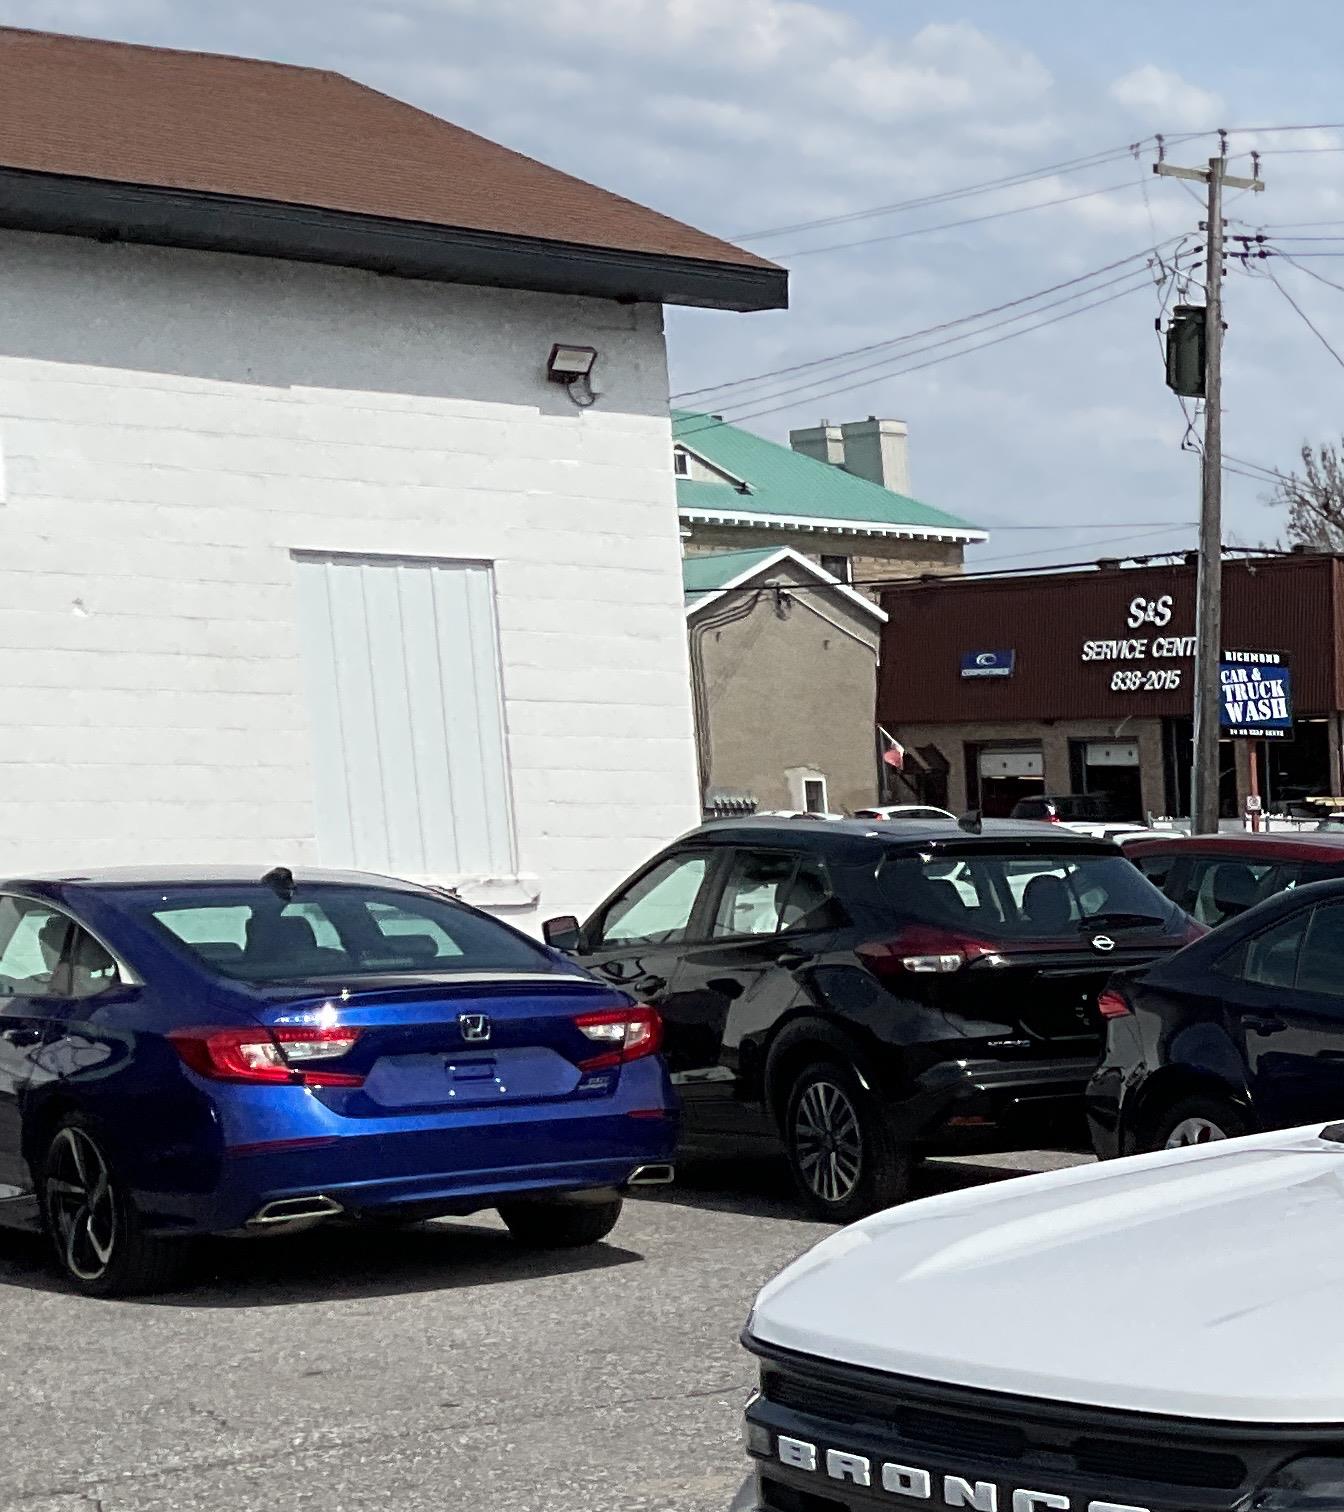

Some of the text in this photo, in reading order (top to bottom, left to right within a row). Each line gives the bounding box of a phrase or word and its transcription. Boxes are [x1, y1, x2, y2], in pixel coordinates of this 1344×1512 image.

[1127, 595, 1173, 628] S&S
[1081, 636, 1198, 661] SERVICE CENT
[1224, 651, 1281, 664] RICHMOND
[1110, 670, 1182, 691] 838-2015
[1220, 667, 1262, 684] CAR &
[1221, 679, 1285, 702] TRUCK
[1224, 697, 1289, 723] WASH
